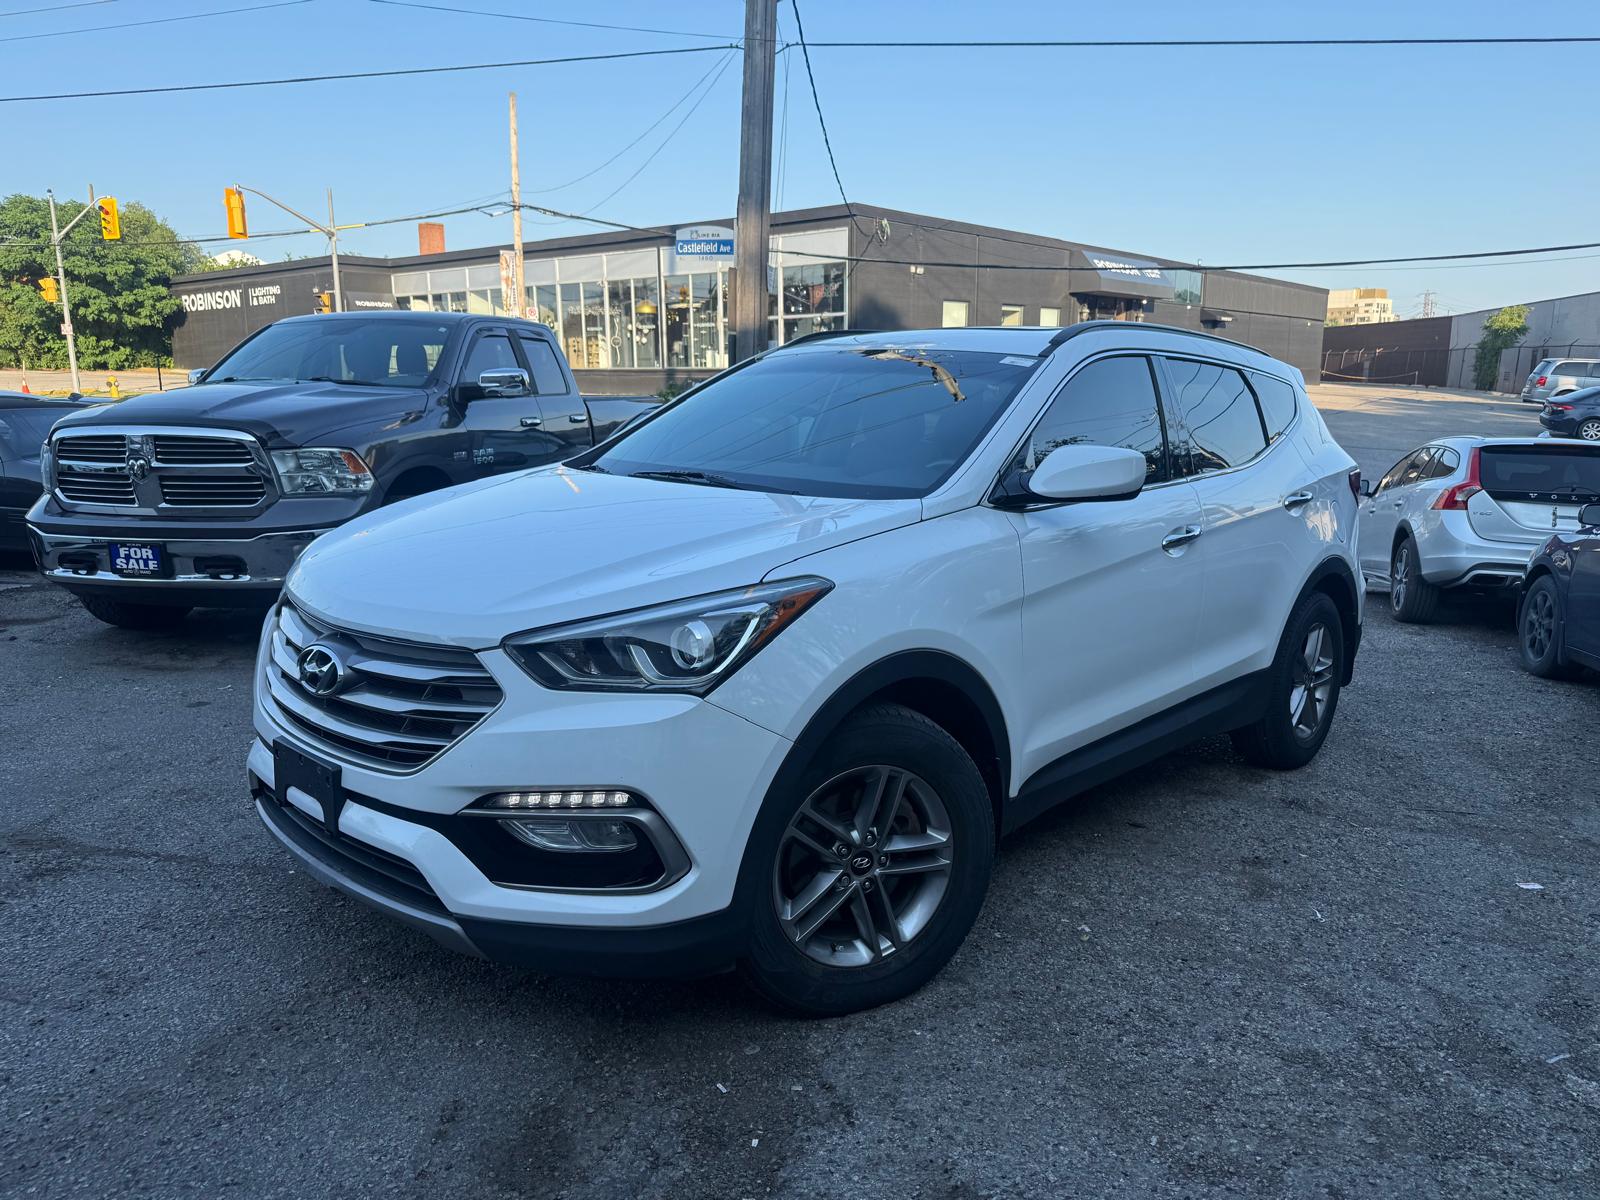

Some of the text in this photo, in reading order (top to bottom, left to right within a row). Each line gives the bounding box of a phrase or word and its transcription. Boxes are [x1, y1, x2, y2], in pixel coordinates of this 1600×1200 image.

[677, 242, 731, 253] Castlefield Ave
[251, 285, 280, 297] LIGHTING
[181, 289, 242, 313] ROBINSON
[259, 295, 276, 305] BATH
[355, 300, 393, 308] ROBINSON
[472, 448, 494, 456] RAM
[473, 455, 495, 465] 1500
[119, 547, 154, 559] FOR
[115, 558, 160, 571] SALE
